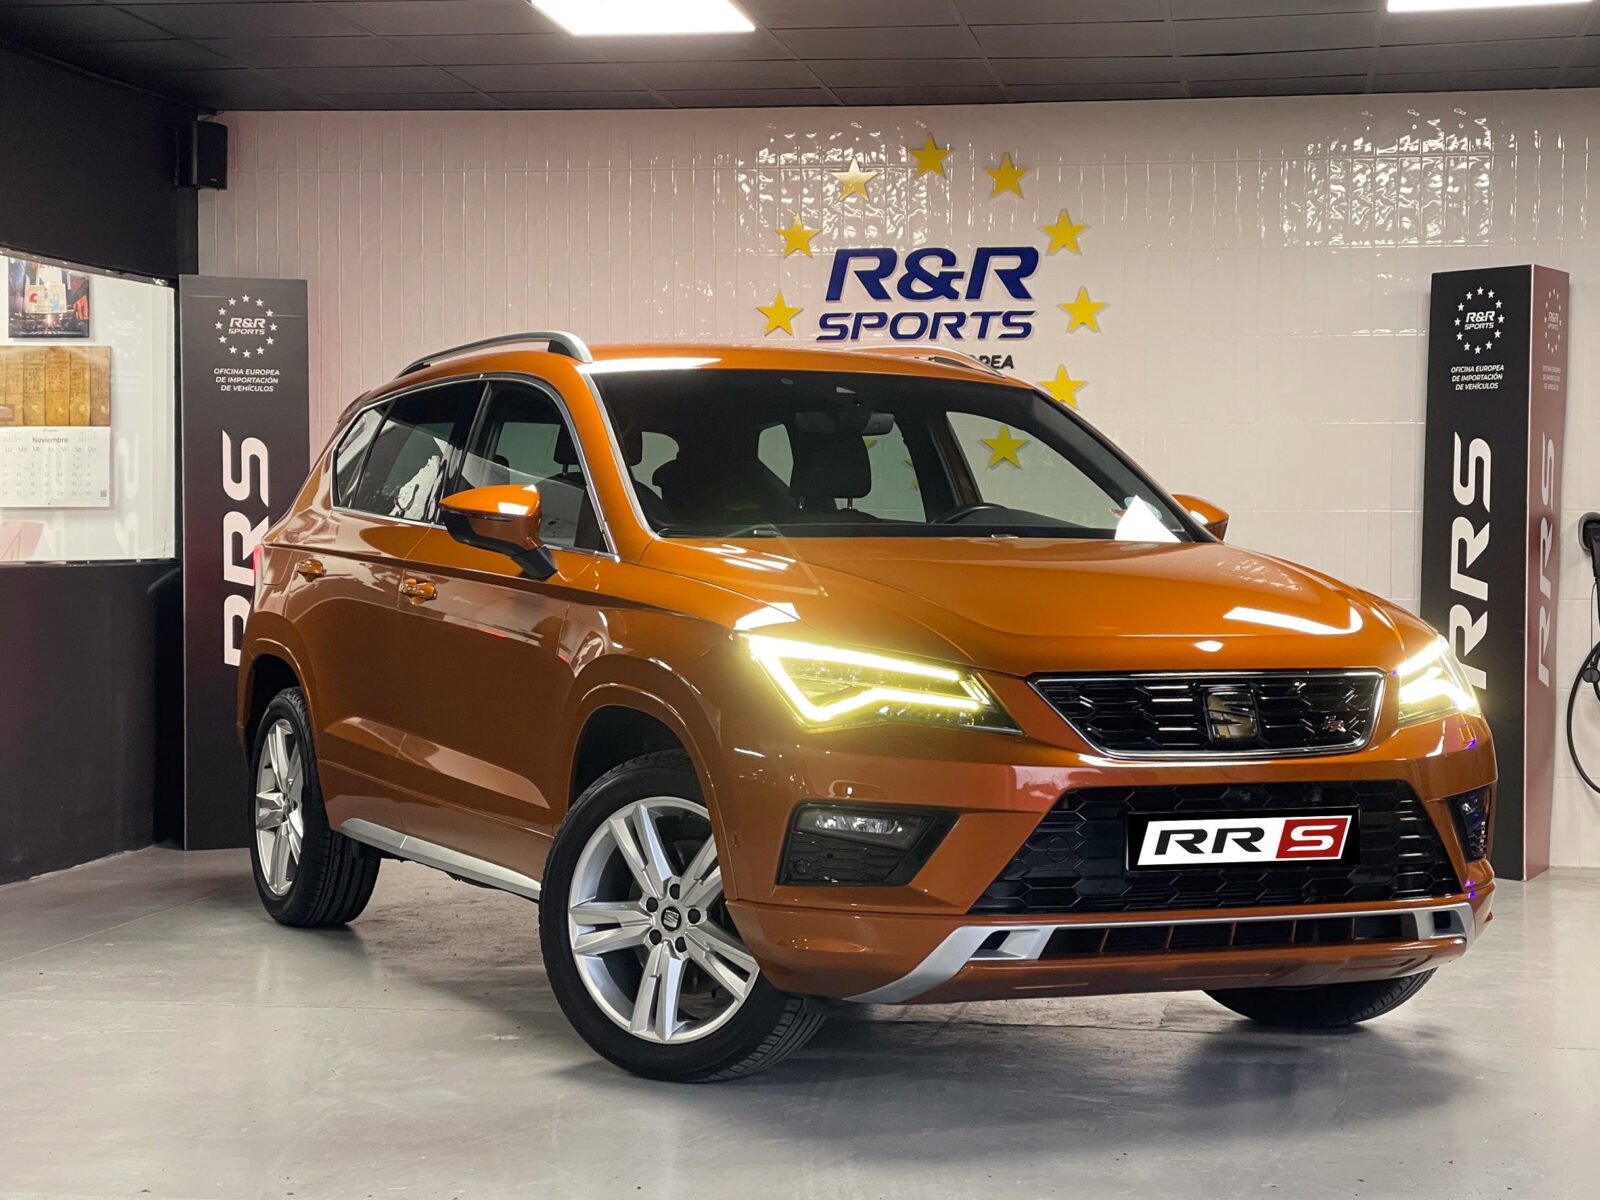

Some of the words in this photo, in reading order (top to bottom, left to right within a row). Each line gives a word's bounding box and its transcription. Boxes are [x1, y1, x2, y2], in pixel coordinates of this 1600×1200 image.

[825, 246, 1040, 302] R&R
[1466, 310, 1496, 323] R&R
[229, 317, 266, 328] R&R
[815, 310, 1038, 342] SPORTS
[1464, 322, 1495, 330] SPORTS
[213, 367, 244, 375] OFICINA
[245, 368, 280, 376] EUROPEA
[1450, 365, 1475, 373] OFICINA
[1475, 364, 1505, 372] EUROPEA
[227, 376, 279, 384] IMPORTACIÓN
[1461, 373, 1503, 381] IMPORTACIÓN
[232, 384, 274, 392] VEHÍCULOS
[1455, 383, 1464, 391] DE
[1465, 382, 1499, 390] VEHÍCULOS
[32, 436, 69, 444] Noviembre
[1449, 431, 1492, 690] RRS
[1538, 431, 1556, 688] RRS
[1154, 824, 1339, 856] RRS
